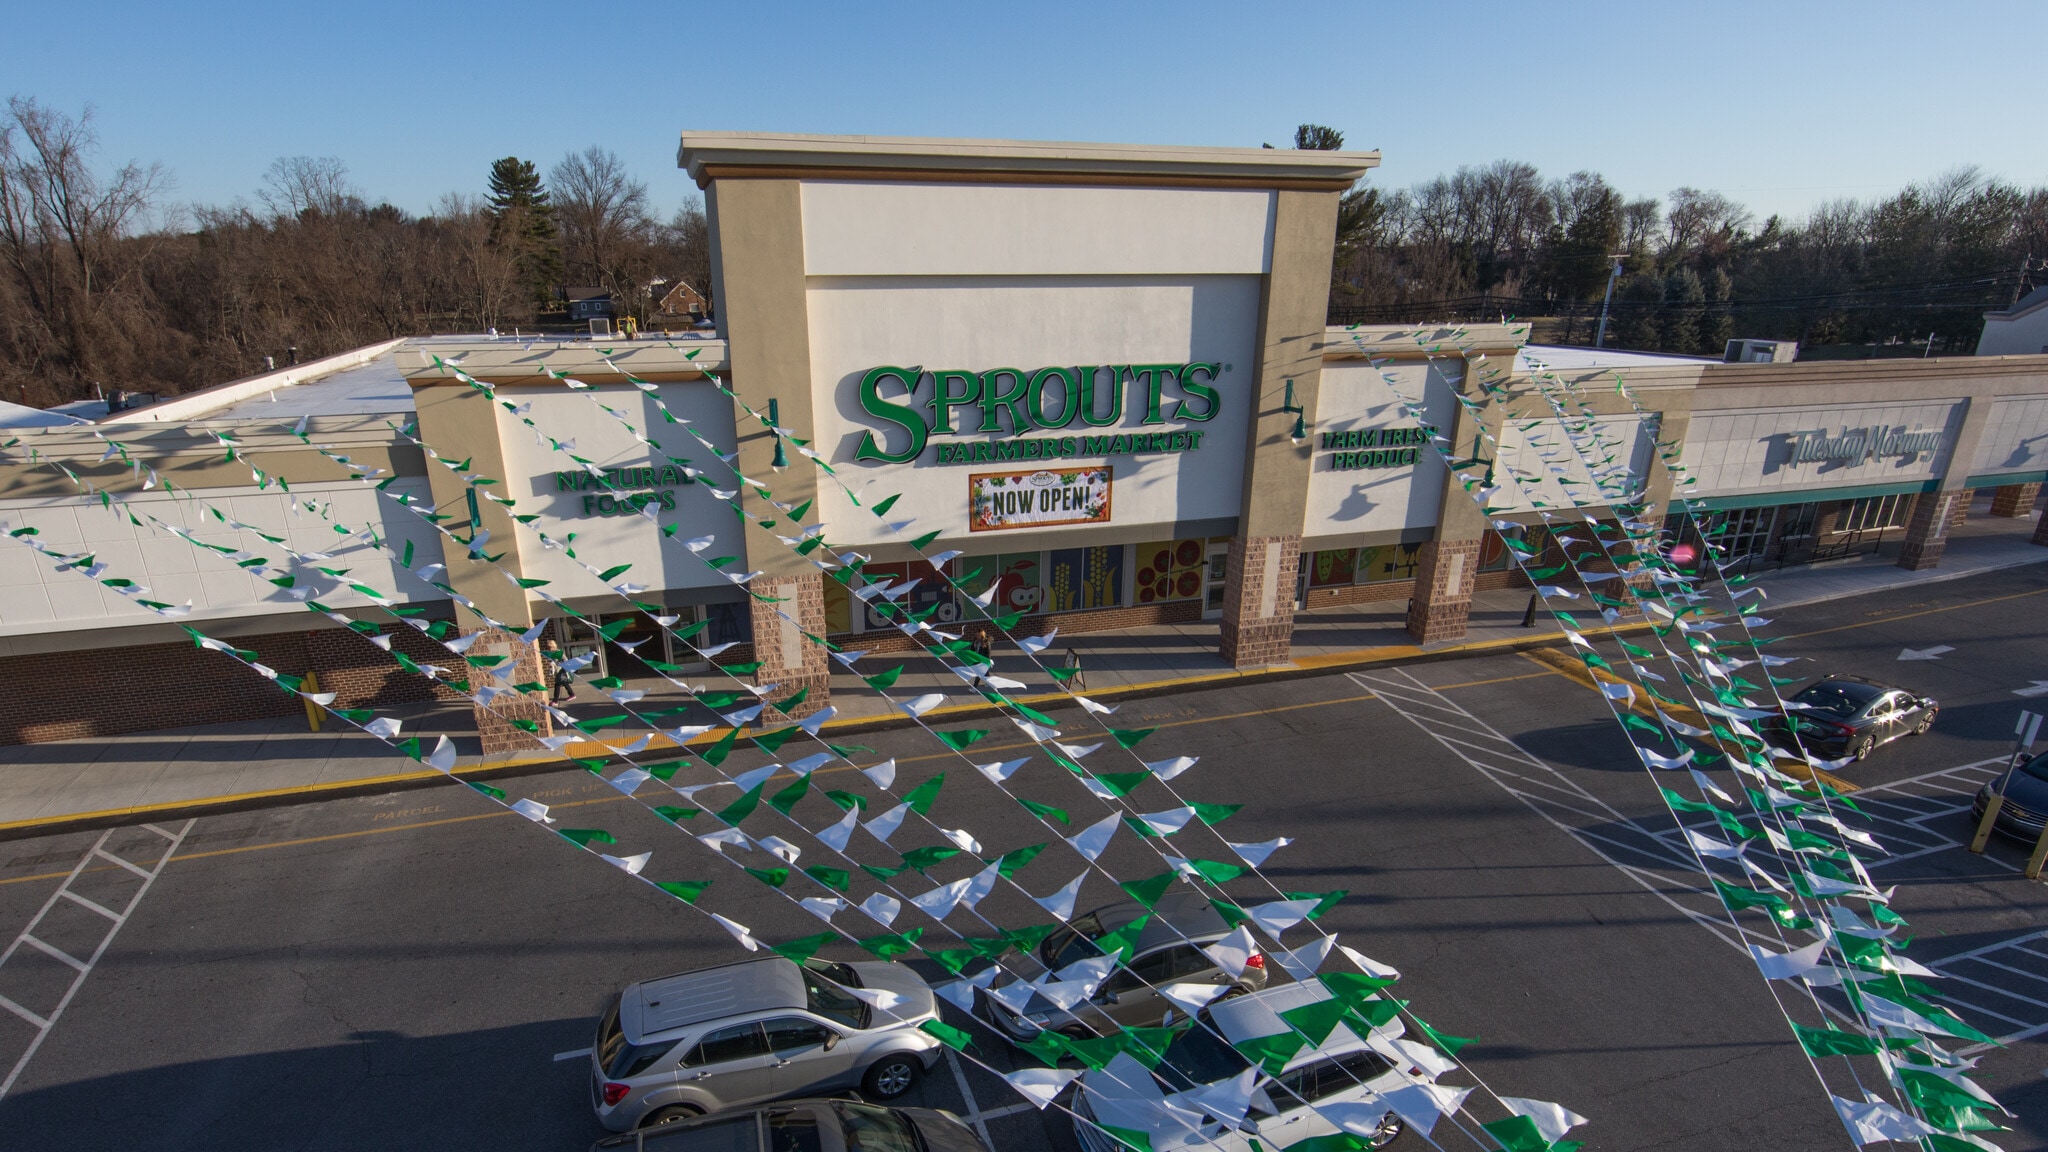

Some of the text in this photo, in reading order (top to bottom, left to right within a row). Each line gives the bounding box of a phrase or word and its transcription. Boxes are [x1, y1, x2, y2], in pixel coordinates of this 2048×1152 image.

[855, 362, 1222, 464] SPROUTS
[937, 430, 1205, 465] FARMERS MARKET
[1322, 430, 1377, 449] FARM
[1789, 423, 1943, 469] Tuesday Morning
[1333, 448, 1423, 470] PRODUCE
[993, 486, 1091, 516] NOW OPEN!
